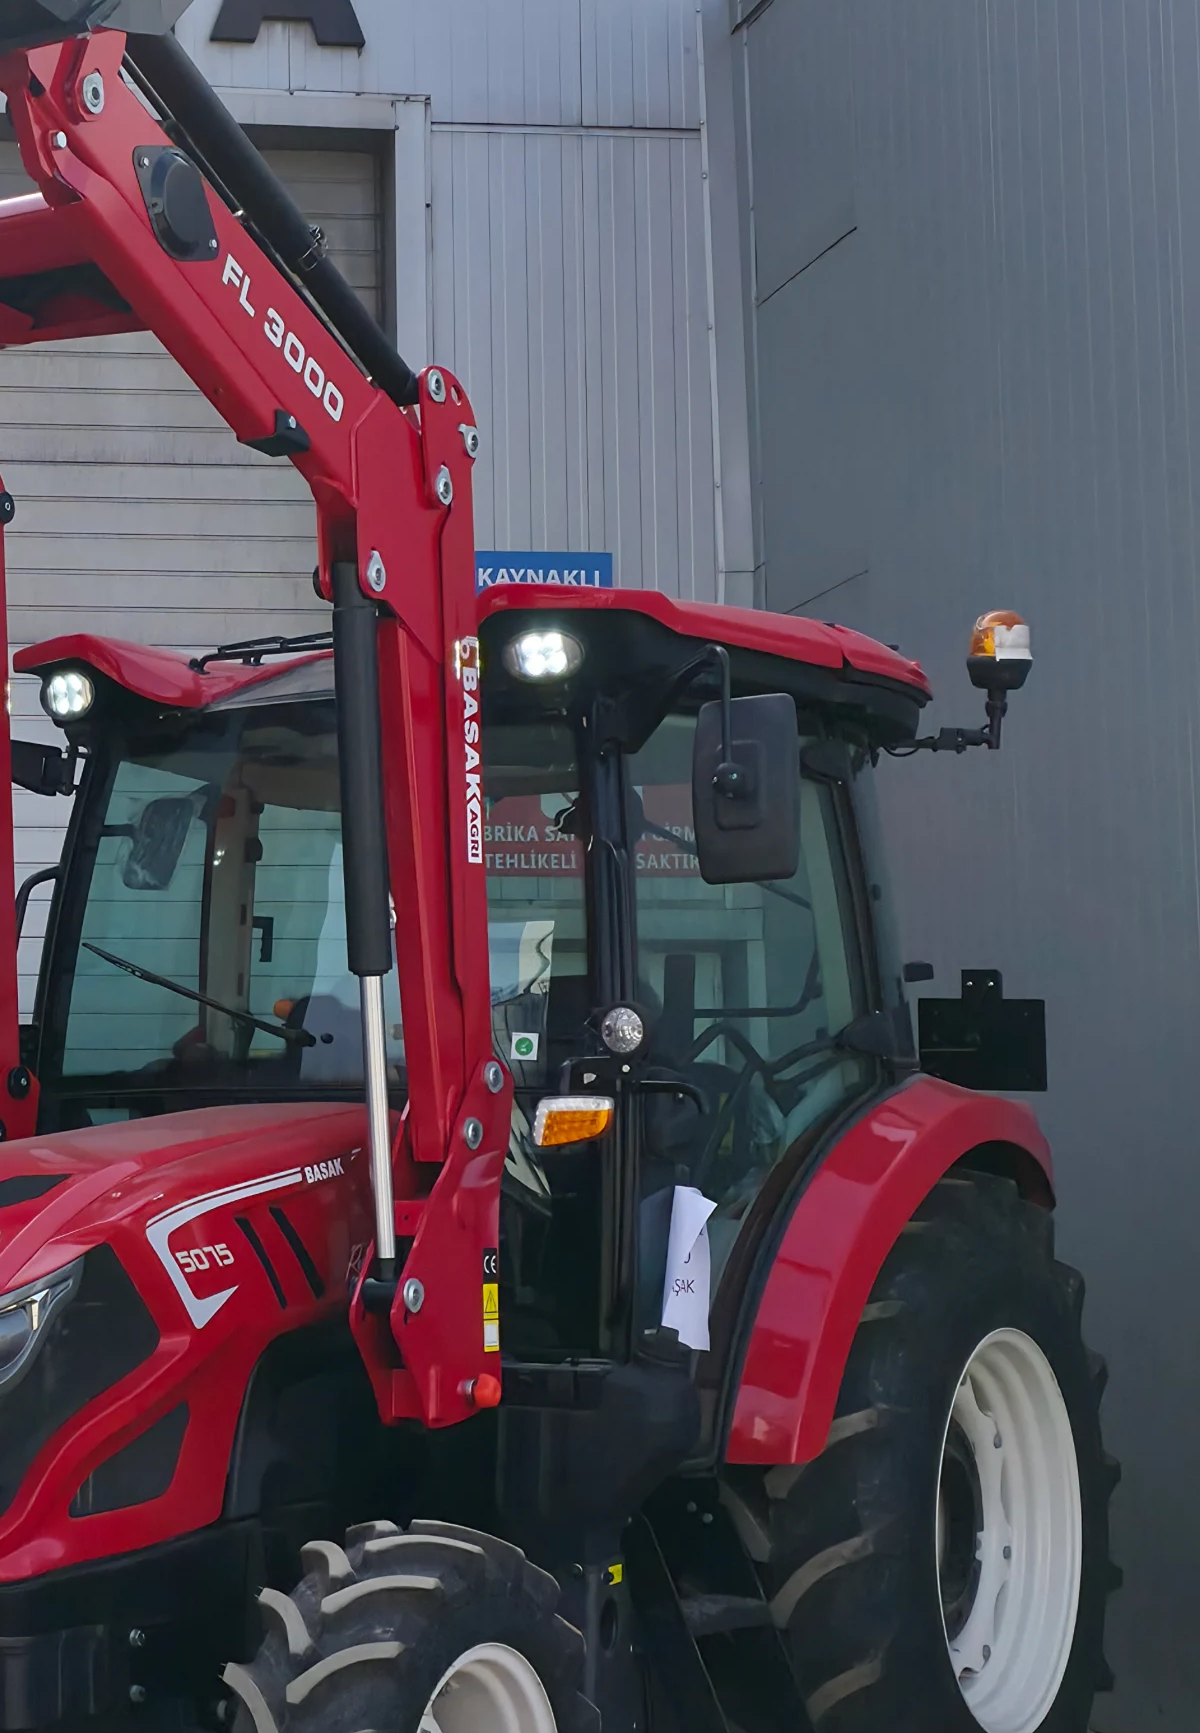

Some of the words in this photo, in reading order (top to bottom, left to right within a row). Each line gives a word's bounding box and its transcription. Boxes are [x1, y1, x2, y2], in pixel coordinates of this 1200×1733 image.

[222, 253, 255, 317] FL
[264, 307, 344, 422] 3000
[462, 667, 482, 804] BASAK
[469, 807, 481, 859] AGRI
[485, 850, 577, 869] TEHLİKELİ
[304, 1158, 344, 1184] BASAK
[175, 1243, 235, 1273] 5075
[672, 1278, 695, 1296] ŞAK
